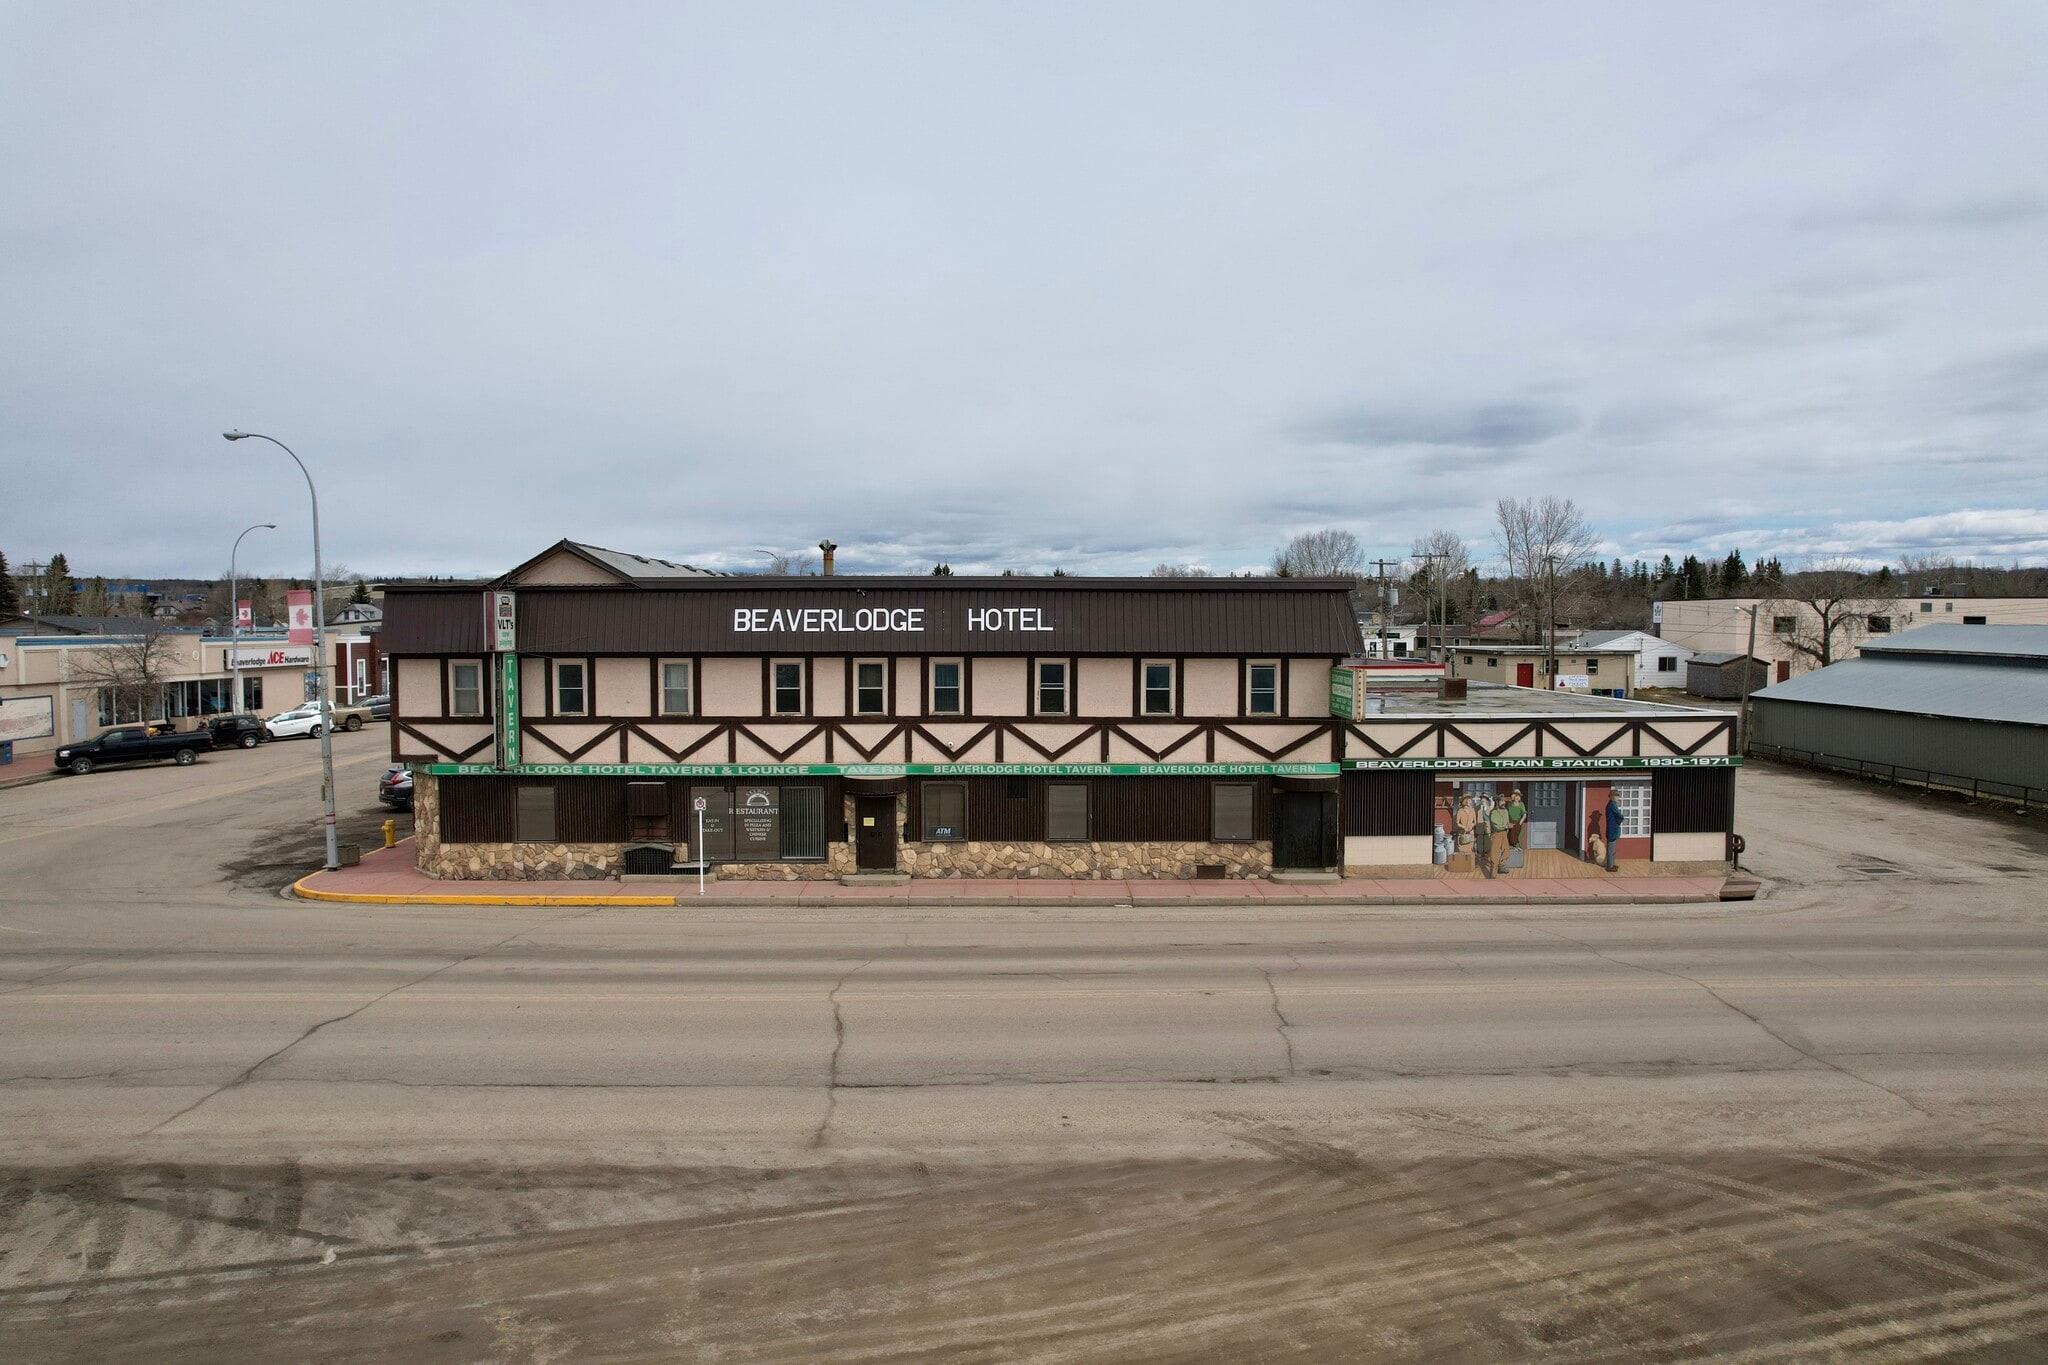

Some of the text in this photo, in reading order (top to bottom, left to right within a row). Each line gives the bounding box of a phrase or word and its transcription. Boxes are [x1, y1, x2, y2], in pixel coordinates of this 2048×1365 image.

[734, 608, 1054, 632] BEAVERLODGE HOTEL
[267, 650, 285, 665] ACE
[285, 655, 310, 664] Hardware
[506, 659, 516, 762] TAVERN
[1355, 757, 1730, 769] BEAVERLODGE TRAIN STATION 1930-1971
[588, 765, 646, 775] HOTEL
[648, 765, 716, 775] TAVERN
[721, 766, 732, 775] &
[738, 765, 809, 775] LOUNGE
[837, 765, 907, 775] TAVERN
[933, 765, 1111, 774] BEAVERLODGE HOTEL TAVERN
[1140, 765, 1316, 774] BEAVERLODGE HOTEL TAVERN
[935, 827, 951, 835] ATM
